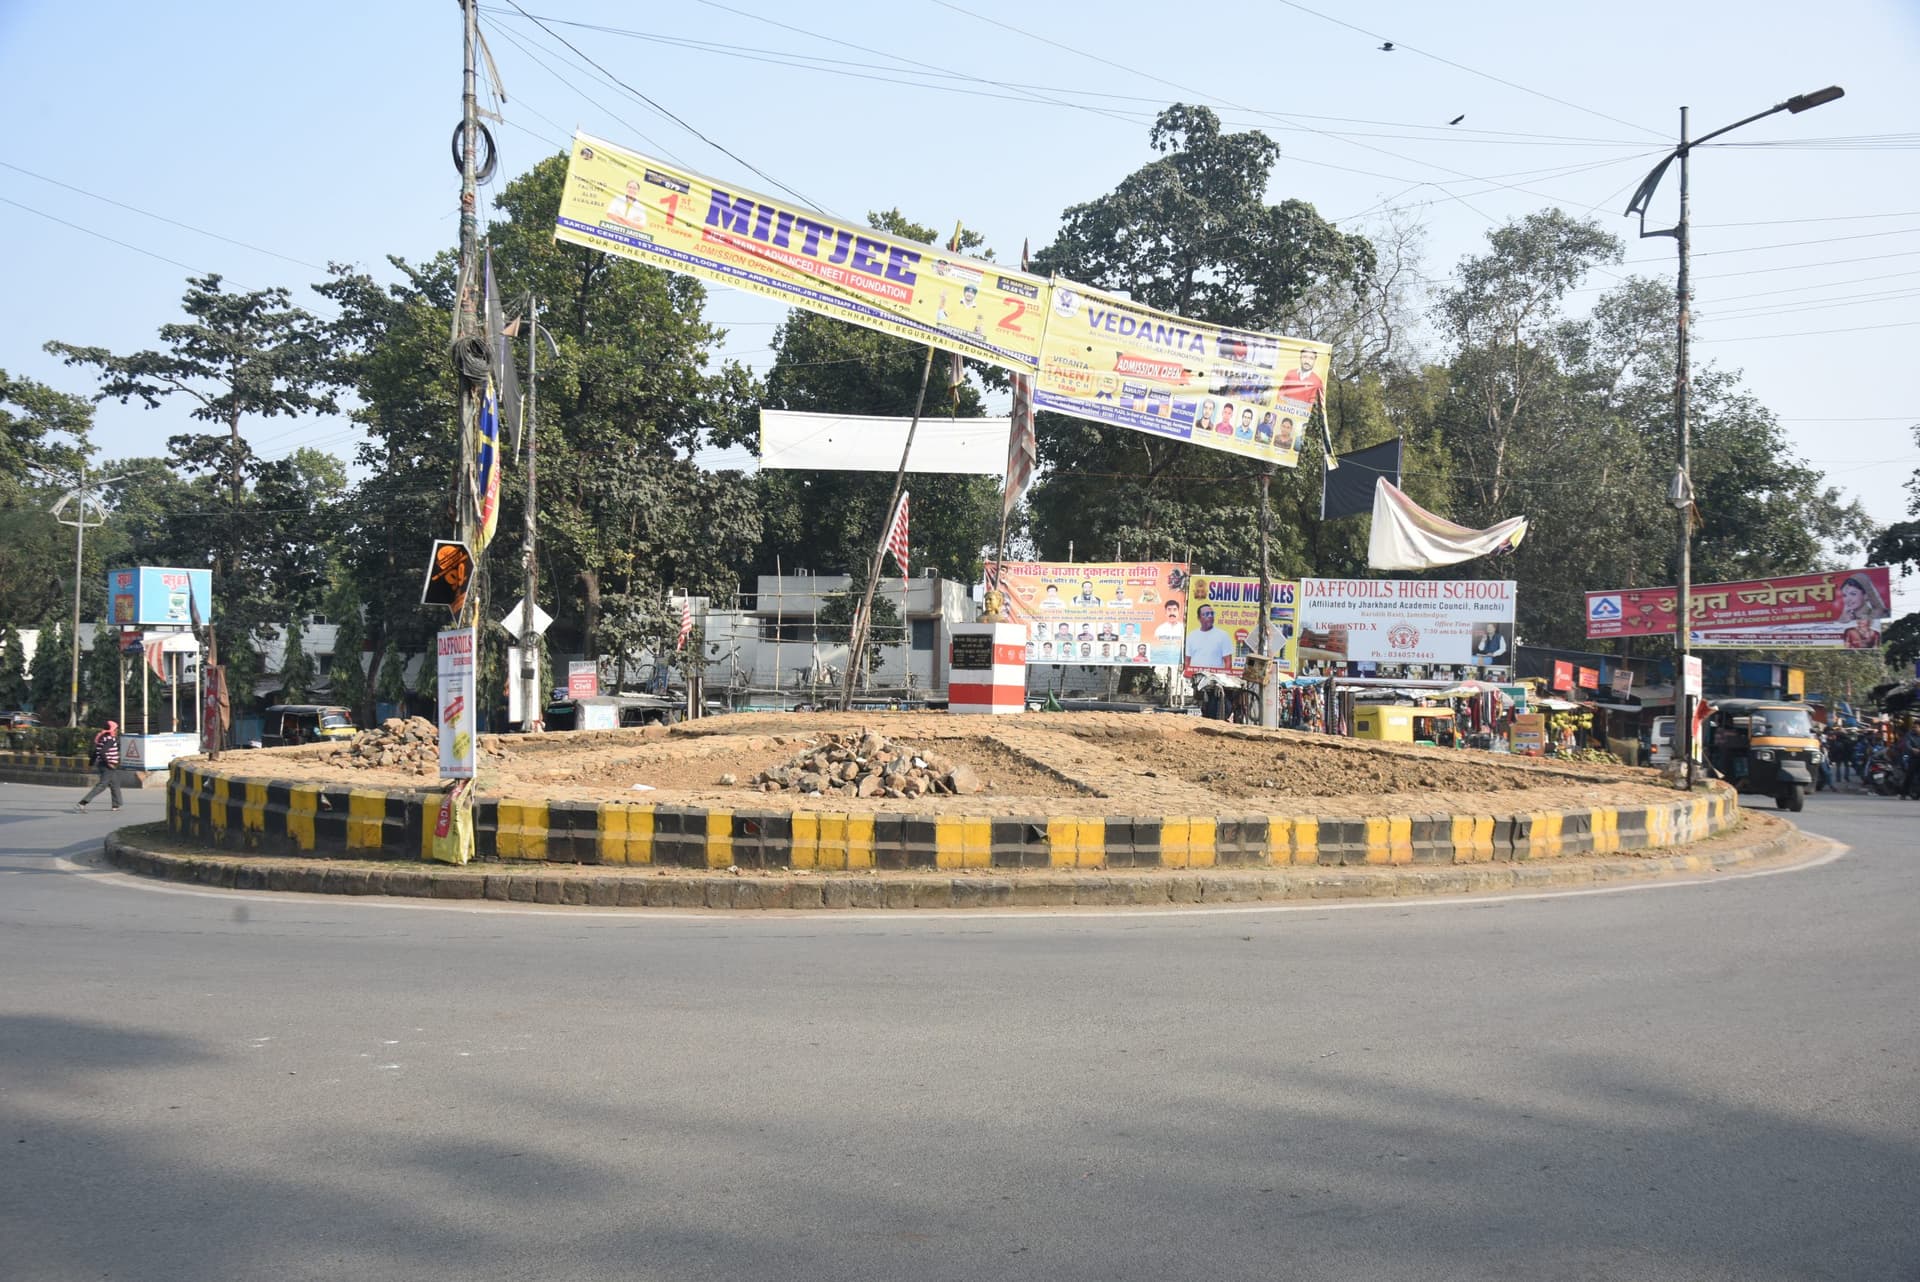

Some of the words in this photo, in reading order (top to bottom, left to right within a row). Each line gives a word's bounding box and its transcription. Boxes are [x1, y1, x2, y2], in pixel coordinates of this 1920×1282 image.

[660, 194, 679, 226] 1
[562, 219, 595, 233] SAKCHI
[596, 228, 630, 244] CENTER
[704, 188, 922, 286] MIITJEE
[692, 242, 746, 265] ADMISSION
[763, 248, 814, 272] ADVANCED
[819, 265, 843, 281] NEET
[850, 274, 907, 300] FOUNDATION
[587, 235, 609, 247] OUR
[612, 242, 647, 258] OTHER
[650, 253, 696, 273] CENTRES
[709, 270, 740, 285] TELCO
[752, 283, 788, 299] NASHIK
[799, 296, 829, 311] PATNA
[840, 308, 884, 327] CHHAPRA
[894, 324, 948, 346] BEGUSARAI
[997, 295, 1026, 333] 2
[1085, 307, 1209, 354] VEDANTA
[1116, 355, 1160, 379] ADMISSION
[1160, 364, 1181, 380] OPEN
[1083, 568, 1125, 579] दुकानदार
[1128, 566, 1158, 577] समिति
[1208, 582, 1240, 602] SAHU
[1242, 583, 1294, 604] MOILES
[1304, 580, 1393, 598] DAFFODILS
[1399, 582, 1438, 598] HIGH
[1443, 582, 1510, 599] SCHOOL
[1309, 600, 1346, 608] (Affiliated
[1348, 600, 1356, 610] by
[1438, 602, 1471, 610] Council,
[1473, 602, 1505, 612] Ranchi)
[1347, 622, 1368, 630] STD.
[1370, 622, 1377, 630] X
[438, 634, 472, 656] DAFFODILS
